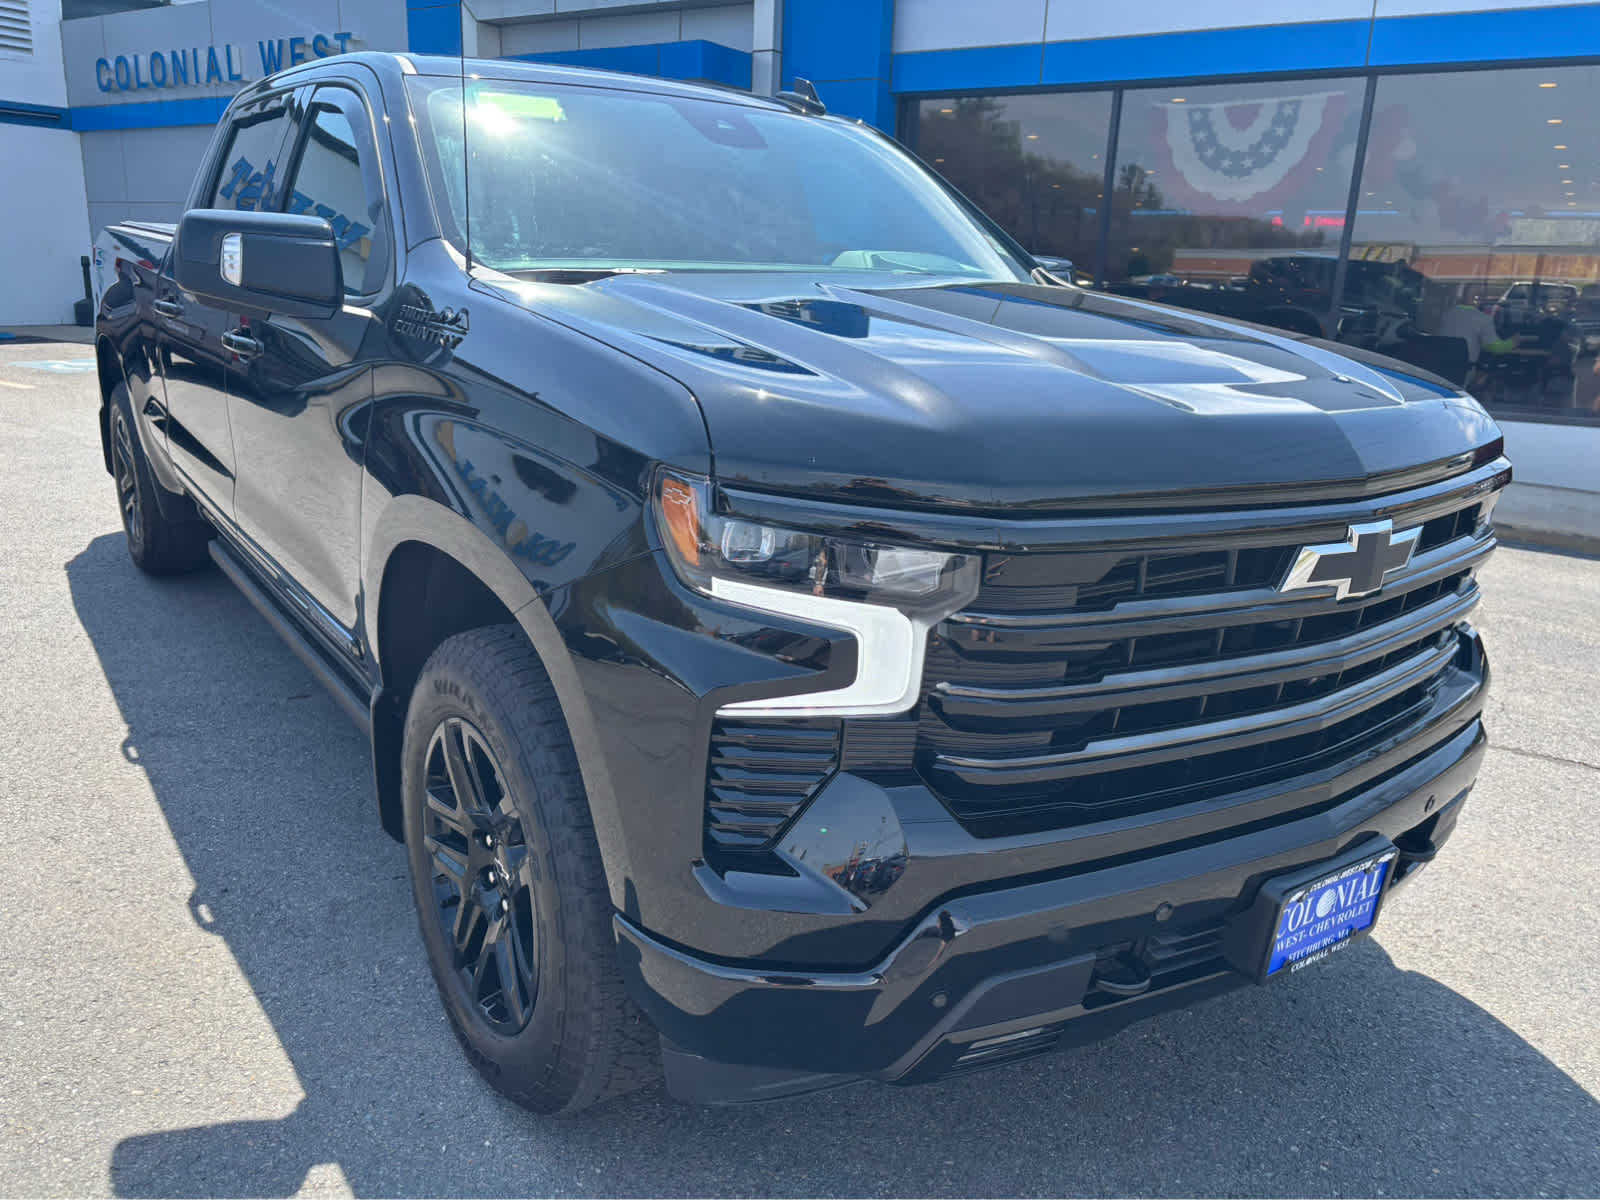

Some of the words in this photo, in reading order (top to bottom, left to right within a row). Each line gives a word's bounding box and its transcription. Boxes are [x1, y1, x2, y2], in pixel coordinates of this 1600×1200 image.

[96, 44, 242, 93] COLONIAL
[258, 32, 352, 77] WEST
[394, 319, 464, 350] COUNTRY
